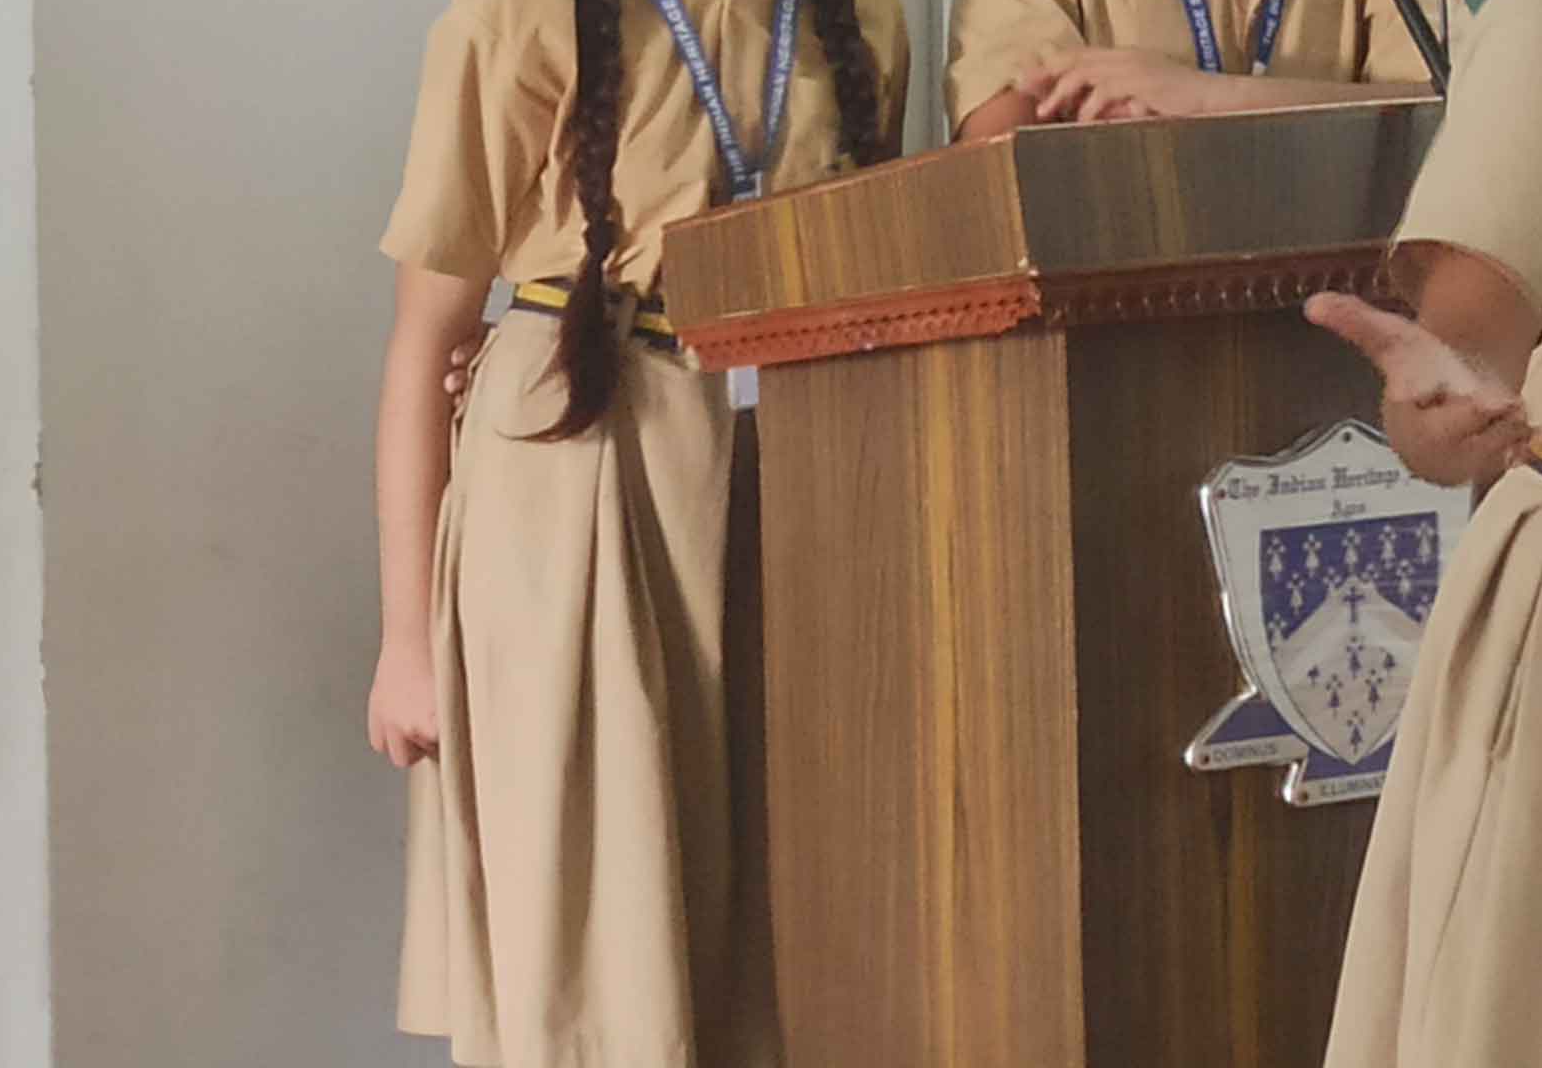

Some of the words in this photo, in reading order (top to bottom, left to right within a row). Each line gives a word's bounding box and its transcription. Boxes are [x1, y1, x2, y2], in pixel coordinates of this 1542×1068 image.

[701, 85, 735, 147] INDIAN
[1227, 477, 1260, 500] The
[1266, 474, 1326, 497] Indian
[1331, 465, 1401, 490] Heritage
